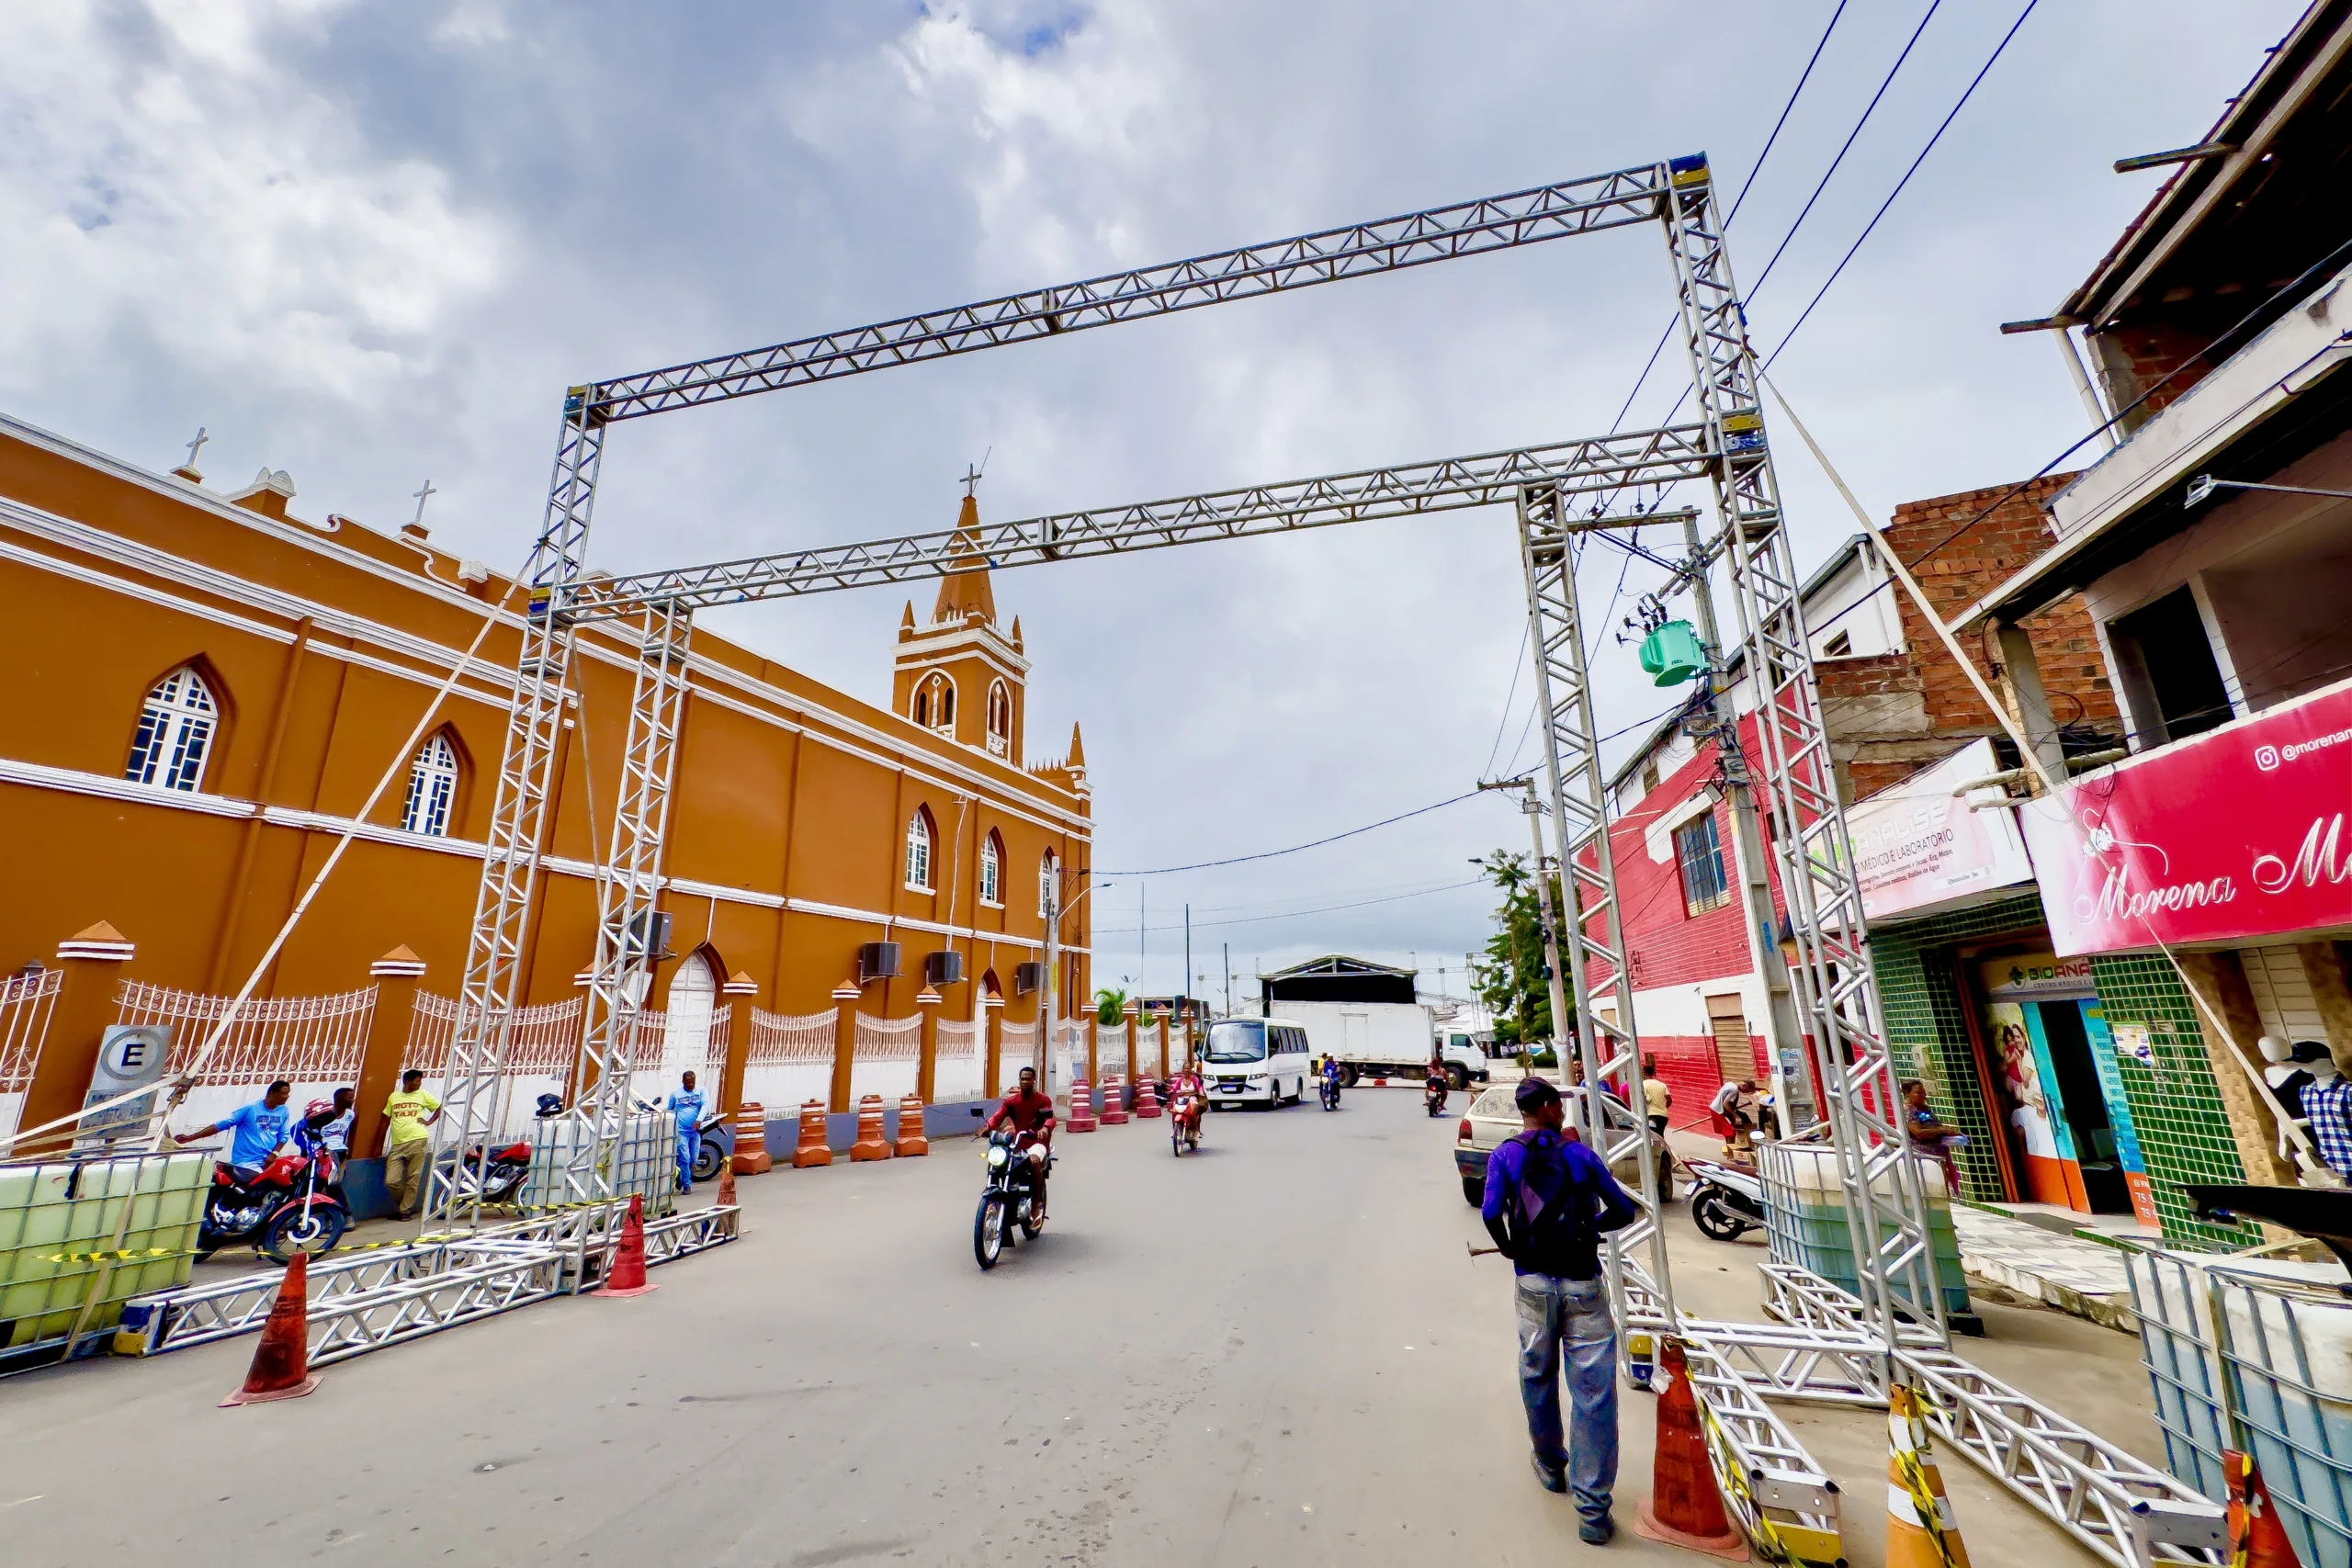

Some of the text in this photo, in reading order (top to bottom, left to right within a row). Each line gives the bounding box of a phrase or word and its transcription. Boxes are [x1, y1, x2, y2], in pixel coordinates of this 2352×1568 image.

[1860, 852, 1890, 872] MÉDICO
[1890, 849, 1896, 863] E
[1895, 829, 1954, 860] LABORATÓRIO
[2073, 863, 2236, 924] Morena
[121, 1043, 146, 1066] E
[393, 1110, 418, 1118] TAXI
